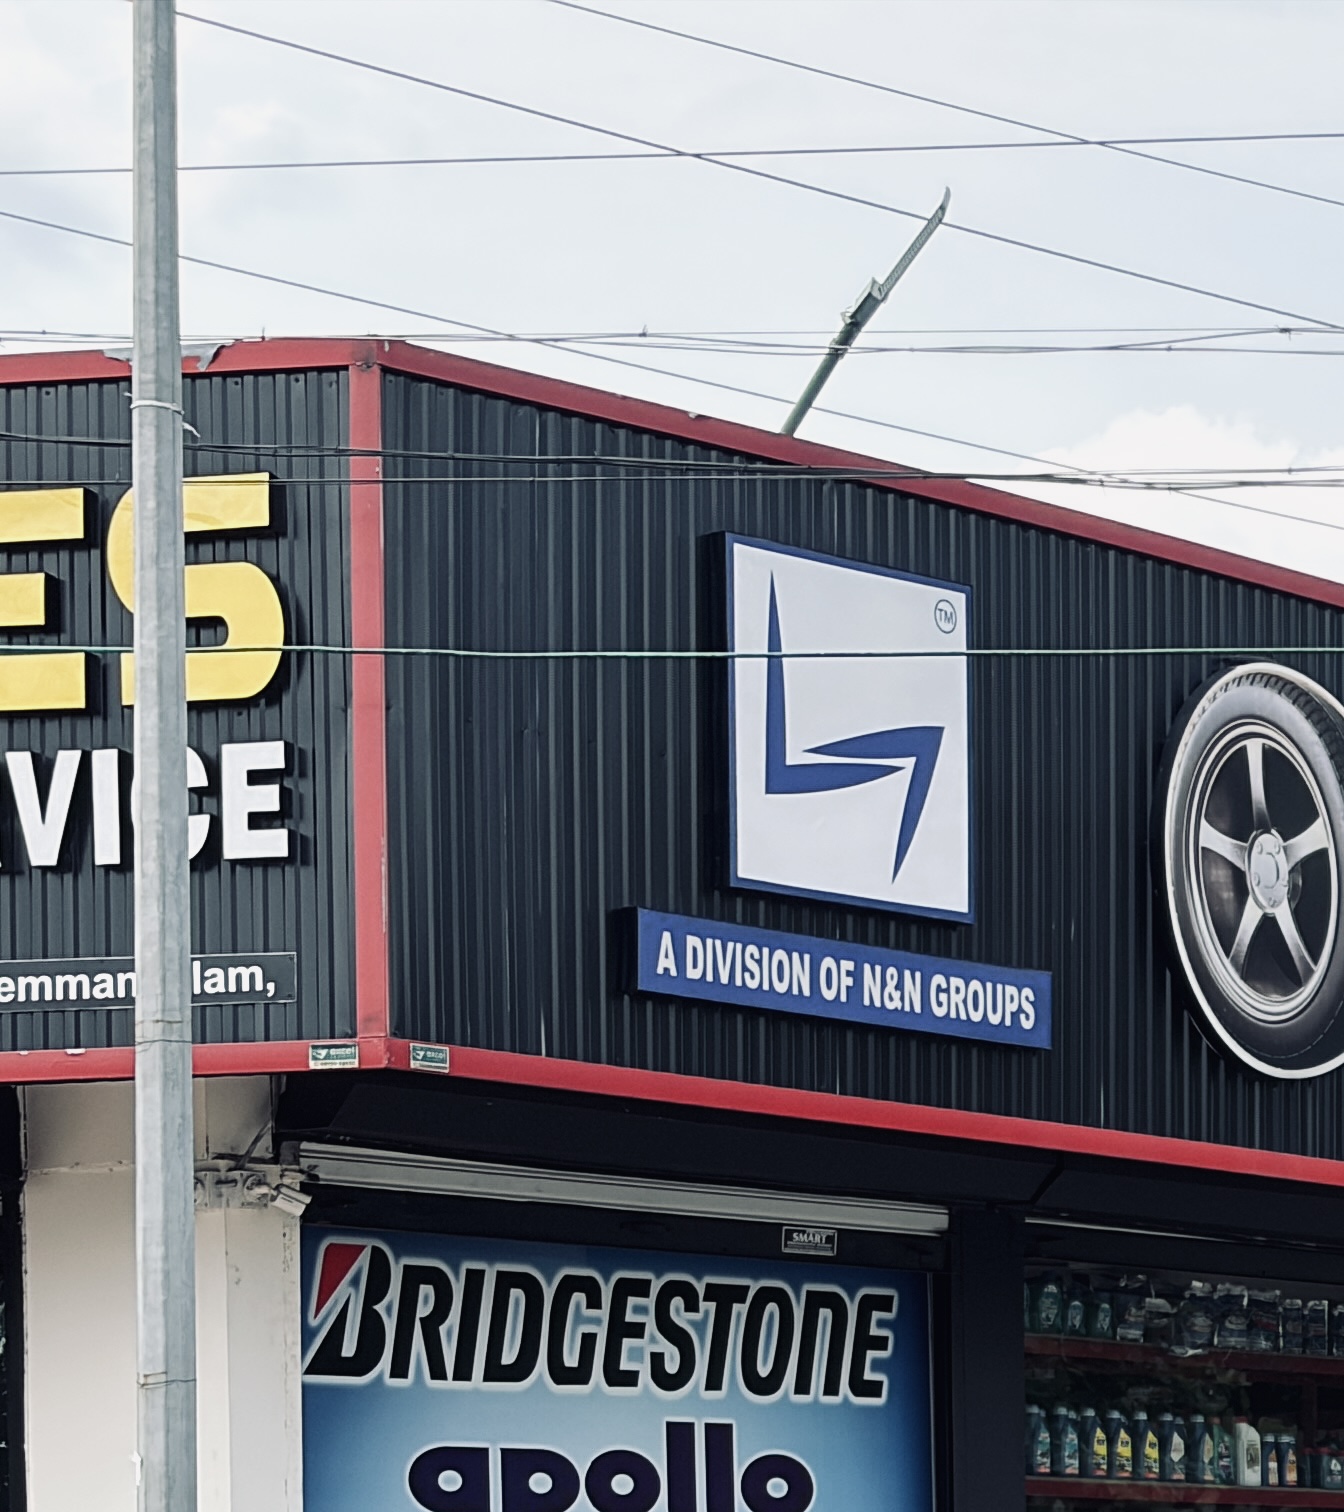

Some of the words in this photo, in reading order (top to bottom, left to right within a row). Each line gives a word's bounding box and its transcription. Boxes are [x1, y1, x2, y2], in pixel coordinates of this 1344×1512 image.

[0, 960, 276, 1003] emmanlam,
[657, 932, 677, 977] A
[686, 935, 811, 998] DIVISION
[819, 959, 854, 1002] OF
[863, 962, 923, 1013] N&N
[930, 974, 1035, 1030] GROUPS
[793, 1231, 826, 1244] SMART
[303, 1243, 896, 1399] BRIDGESTONE
